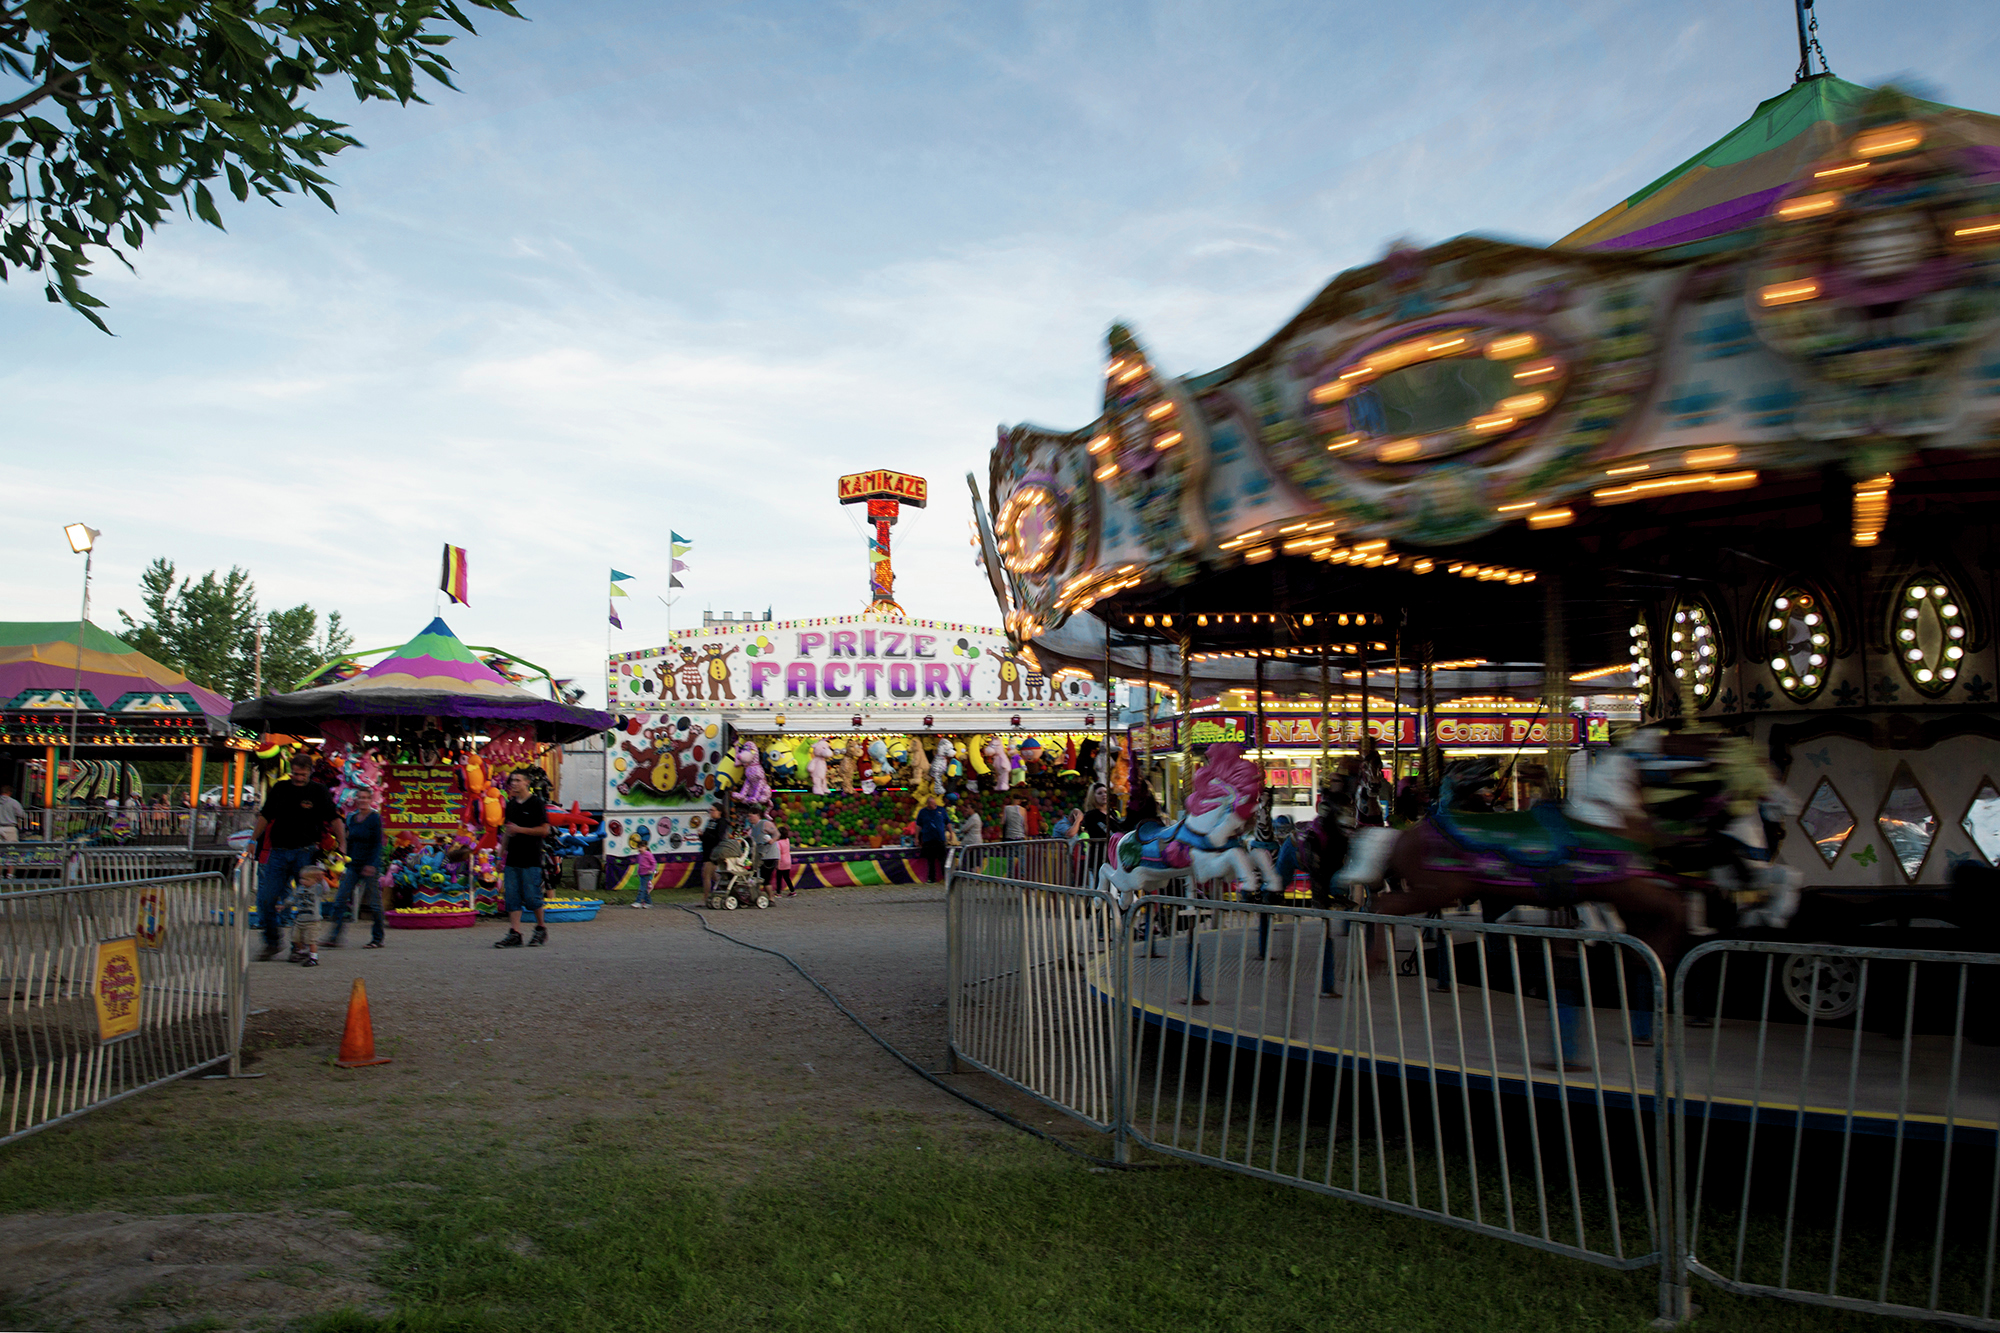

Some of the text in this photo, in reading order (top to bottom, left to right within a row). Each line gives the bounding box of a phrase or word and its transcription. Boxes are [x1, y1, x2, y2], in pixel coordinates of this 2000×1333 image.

[840, 472, 925, 498] KAMIKAZE
[797, 629, 937, 659] PRIZE
[748, 661, 979, 700] FACTORY
[1177, 727, 1246, 745] Lmonade
[1266, 719, 1405, 743] NACHOS
